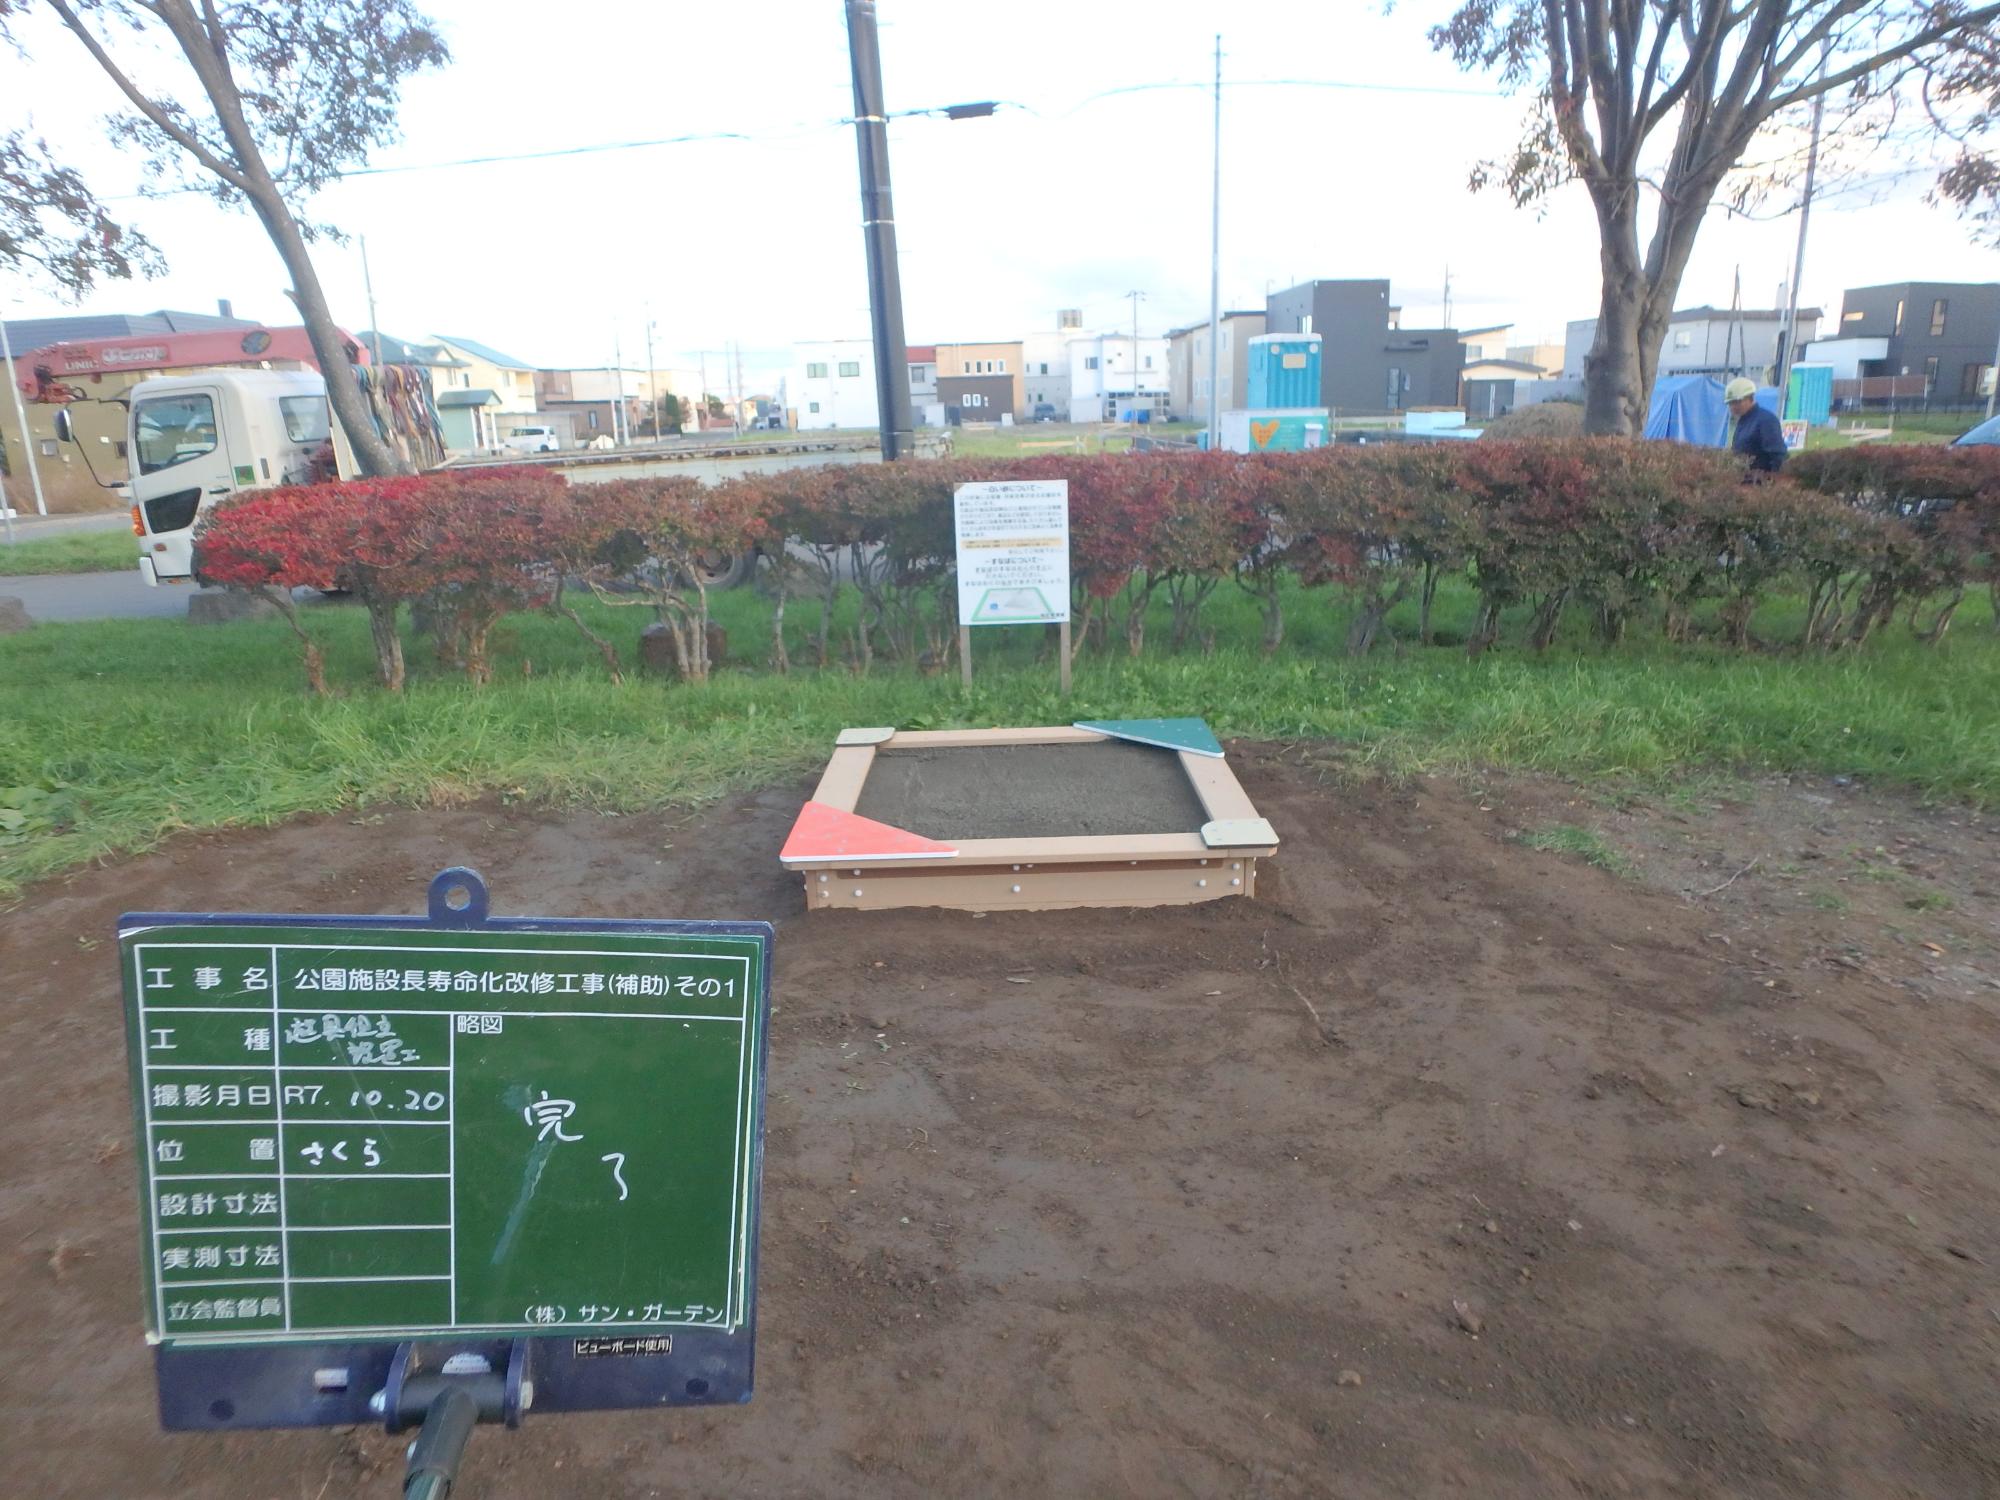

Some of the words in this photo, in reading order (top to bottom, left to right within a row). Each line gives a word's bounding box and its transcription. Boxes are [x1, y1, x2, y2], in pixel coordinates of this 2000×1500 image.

[146, 966, 269, 990] 工事名
[457, 1015, 503, 1034] 略図
[150, 1027, 271, 1051] 工種
[152, 1083, 271, 1107] 撮影月日
[157, 1138, 276, 1162] 位置
[300, 1138, 381, 1167] さくら
[159, 1192, 278, 1217] 設計寸法
[162, 1244, 281, 1270] 実測寸法
[167, 1296, 282, 1321] 立会監督員
[576, 1337, 670, 1354] ビューボード使用
